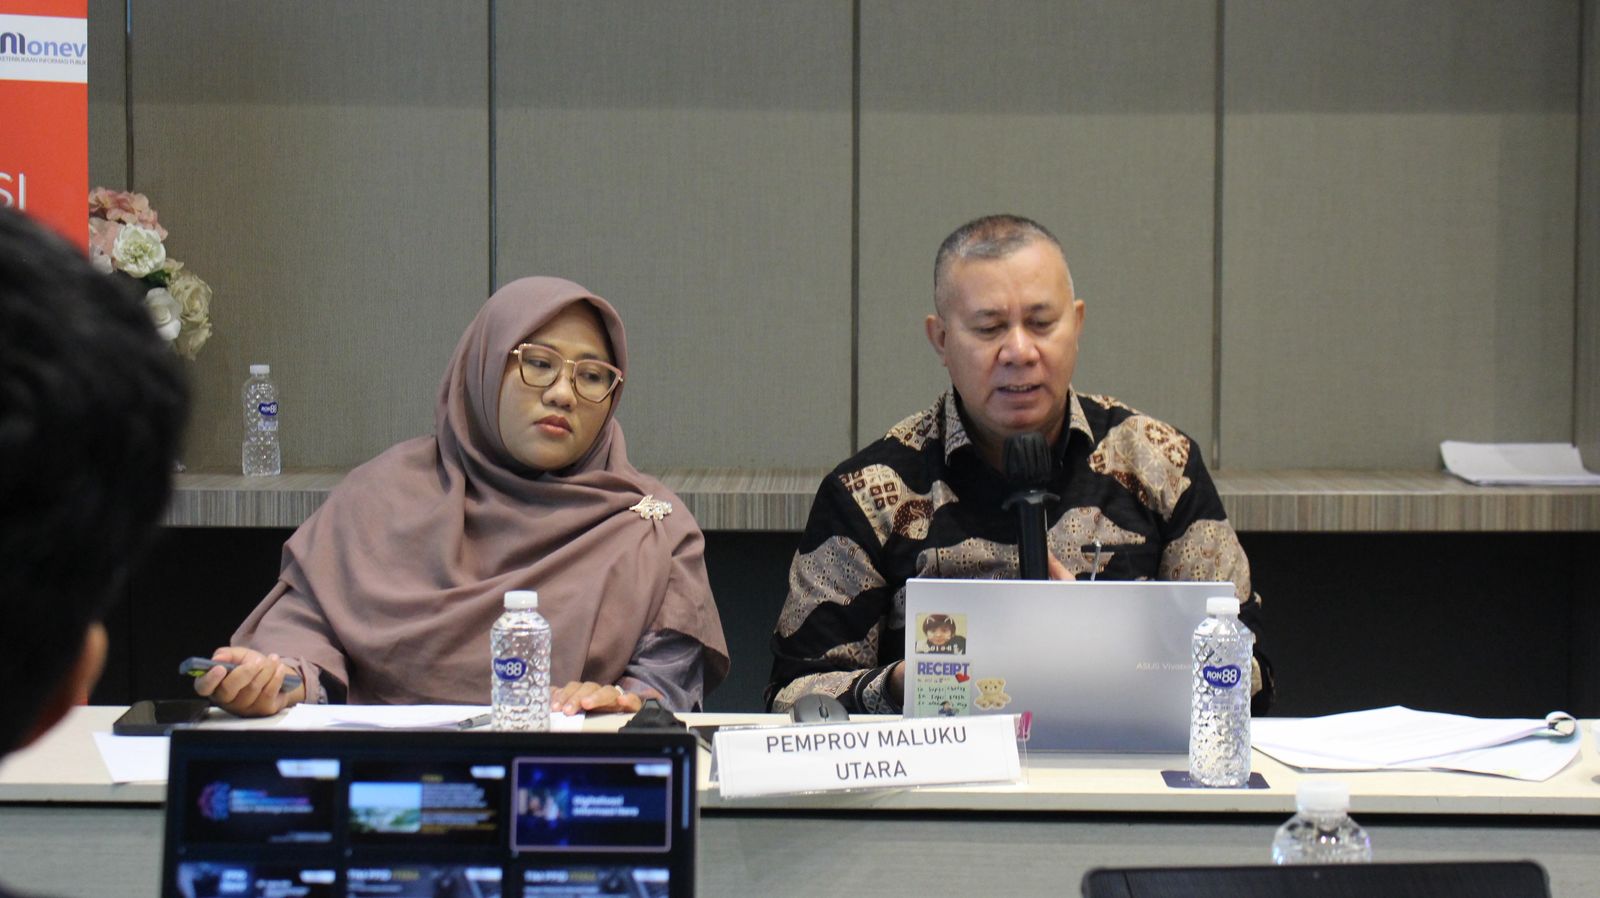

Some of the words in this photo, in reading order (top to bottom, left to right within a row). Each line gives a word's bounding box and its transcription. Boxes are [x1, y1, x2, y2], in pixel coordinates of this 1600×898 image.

[0, 32, 86, 57] Monev
[917, 662, 970, 677] RECEIPT
[1136, 662, 1160, 671] ASUS
[766, 731, 869, 754] PEMPROV
[878, 726, 967, 748] MALUKU
[836, 760, 907, 780] UTARA
